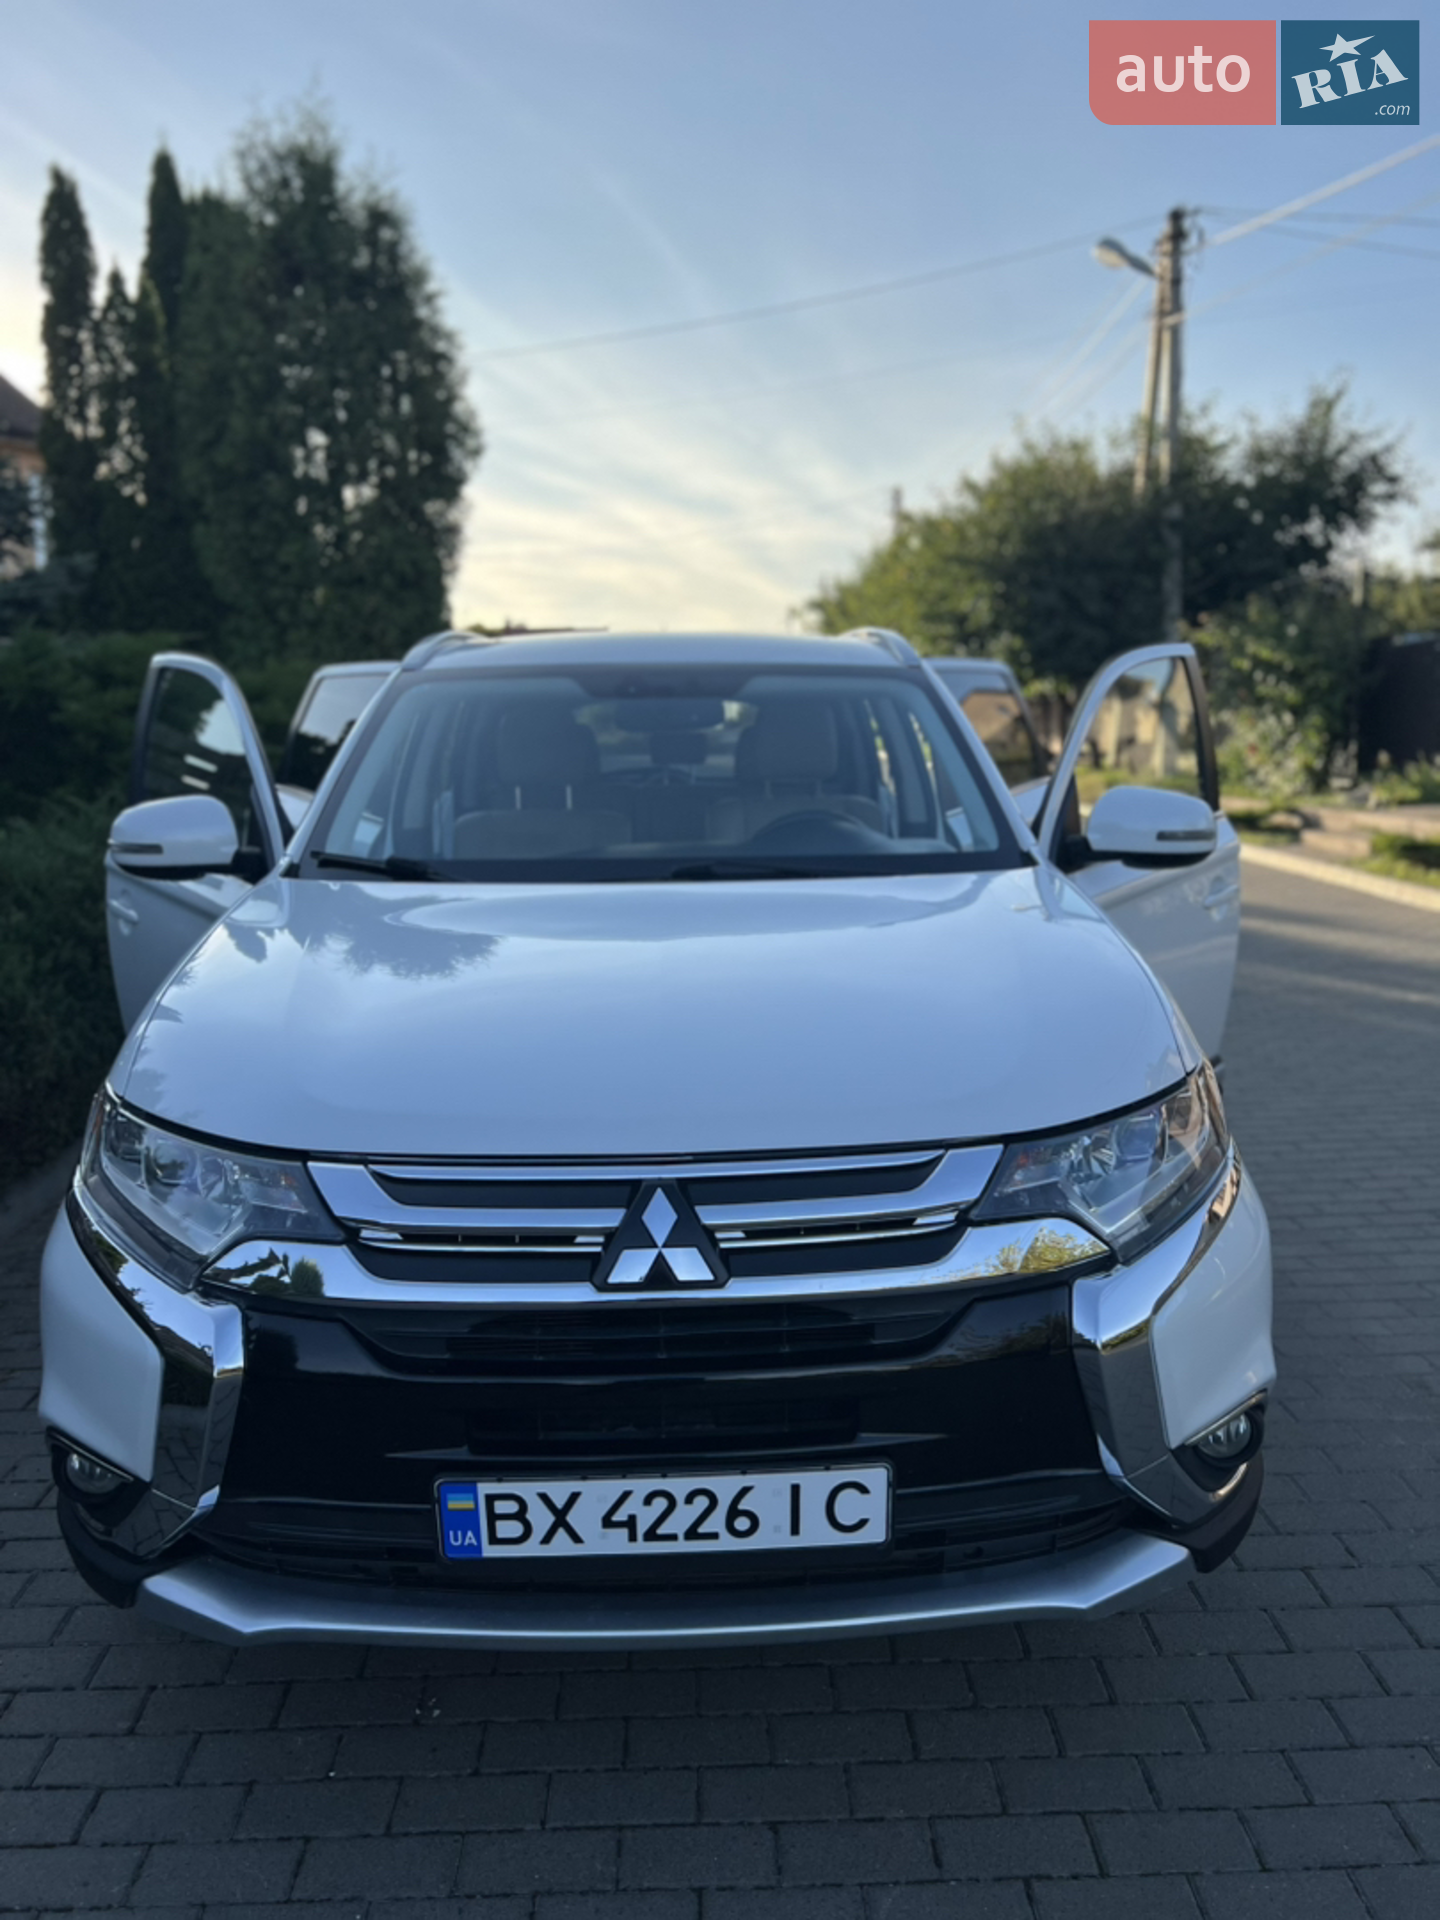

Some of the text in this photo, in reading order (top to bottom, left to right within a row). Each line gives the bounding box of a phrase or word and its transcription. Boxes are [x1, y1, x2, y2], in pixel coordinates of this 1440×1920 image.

[483, 1490, 585, 1546] BX
[601, 1485, 760, 1543] 4226
[449, 1530, 478, 1547] UA
